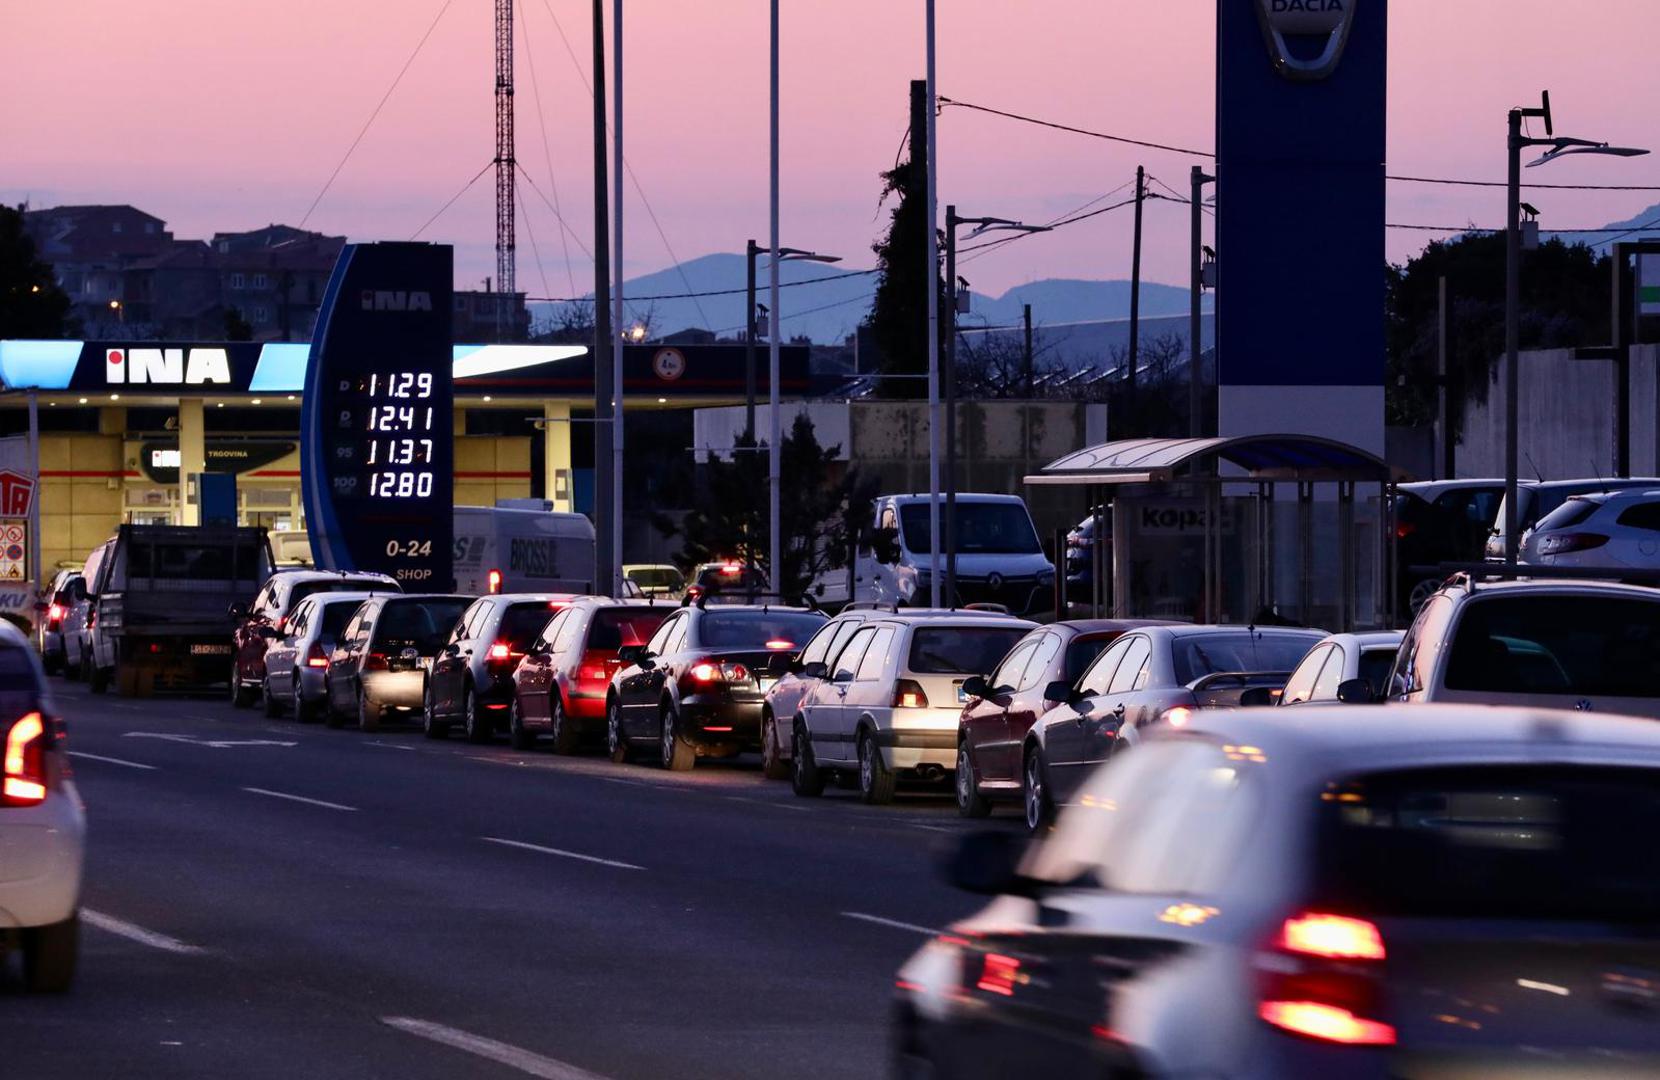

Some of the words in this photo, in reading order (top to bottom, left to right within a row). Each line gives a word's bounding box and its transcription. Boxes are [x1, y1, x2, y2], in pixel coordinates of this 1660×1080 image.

[1271, 0, 1343, 12] DACIA
[338, 380, 351, 391] D
[369, 372, 433, 398] 11.29
[340, 410, 352, 421] D
[370, 405, 433, 431] 12.41
[208, 451, 248, 459] TRGOVINA
[336, 447, 354, 458] 95
[369, 439, 433, 465] 11.37
[333, 476, 357, 488] 100
[370, 472, 433, 497] 12.80
[385, 540, 432, 557] 0-24
[511, 538, 548, 572] BROSS
[395, 568, 432, 580] SHOP
